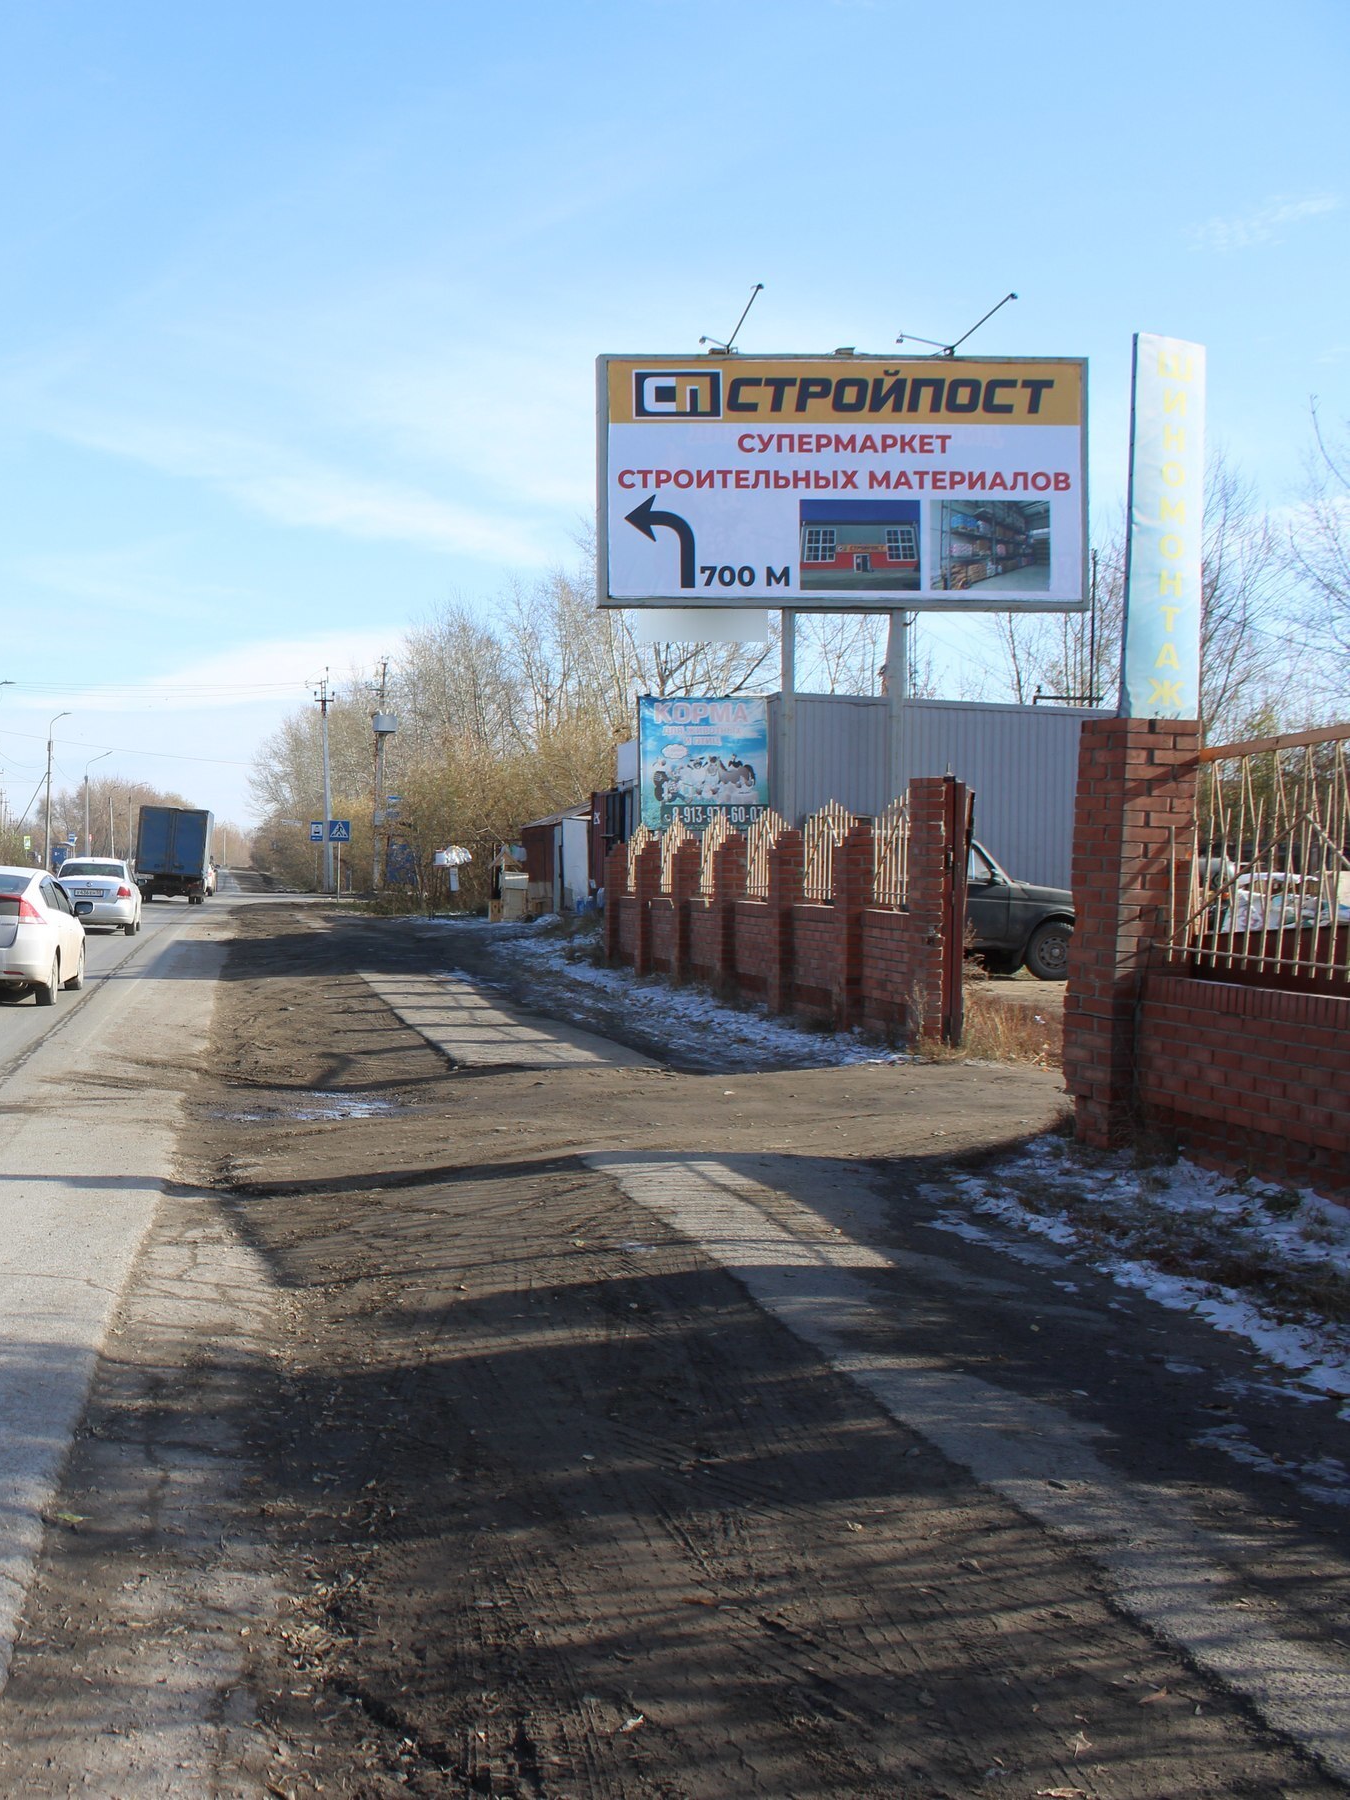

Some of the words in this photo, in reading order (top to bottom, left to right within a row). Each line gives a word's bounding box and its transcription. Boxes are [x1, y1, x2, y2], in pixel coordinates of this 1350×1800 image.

[727, 369, 1055, 415] СТРОЙПОСТ
[737, 434, 951, 454] СУПЕРМАРКЕТ
[617, 469, 857, 490] СТРОИТЕЛЬНЫХ
[869, 470, 1071, 492] МАТЕРИАЛОВ
[1148, 350, 1194, 707] ШИНОМОНТАЖ
[700, 566, 756, 587] 700
[654, 702, 749, 724] КОРМА
